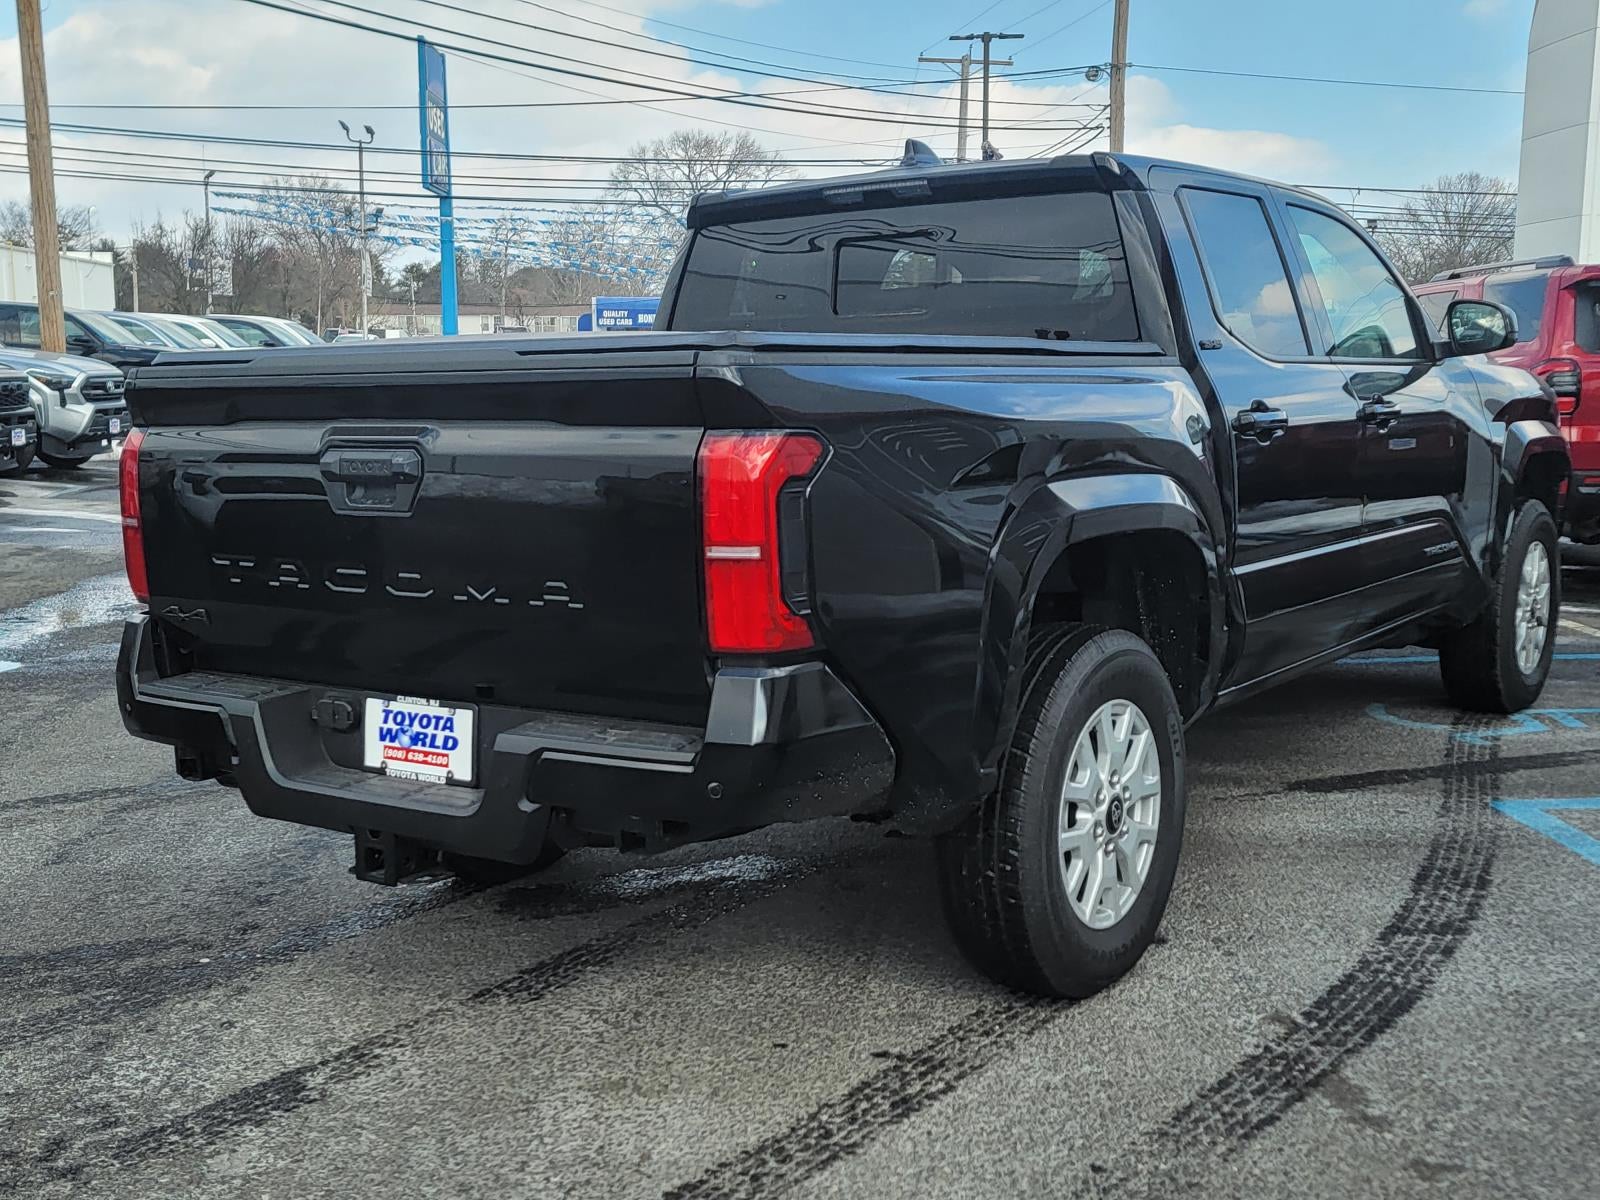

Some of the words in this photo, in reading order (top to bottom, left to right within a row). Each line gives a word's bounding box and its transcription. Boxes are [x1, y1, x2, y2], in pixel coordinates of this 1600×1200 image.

[211, 554, 585, 609] TACOMA
[382, 709, 454, 732] TOYOTA
[378, 727, 459, 751] WORLD
[384, 748, 406, 760] (908)
[385, 768, 417, 781] TOYOTA
[418, 772, 447, 785] WORLD
